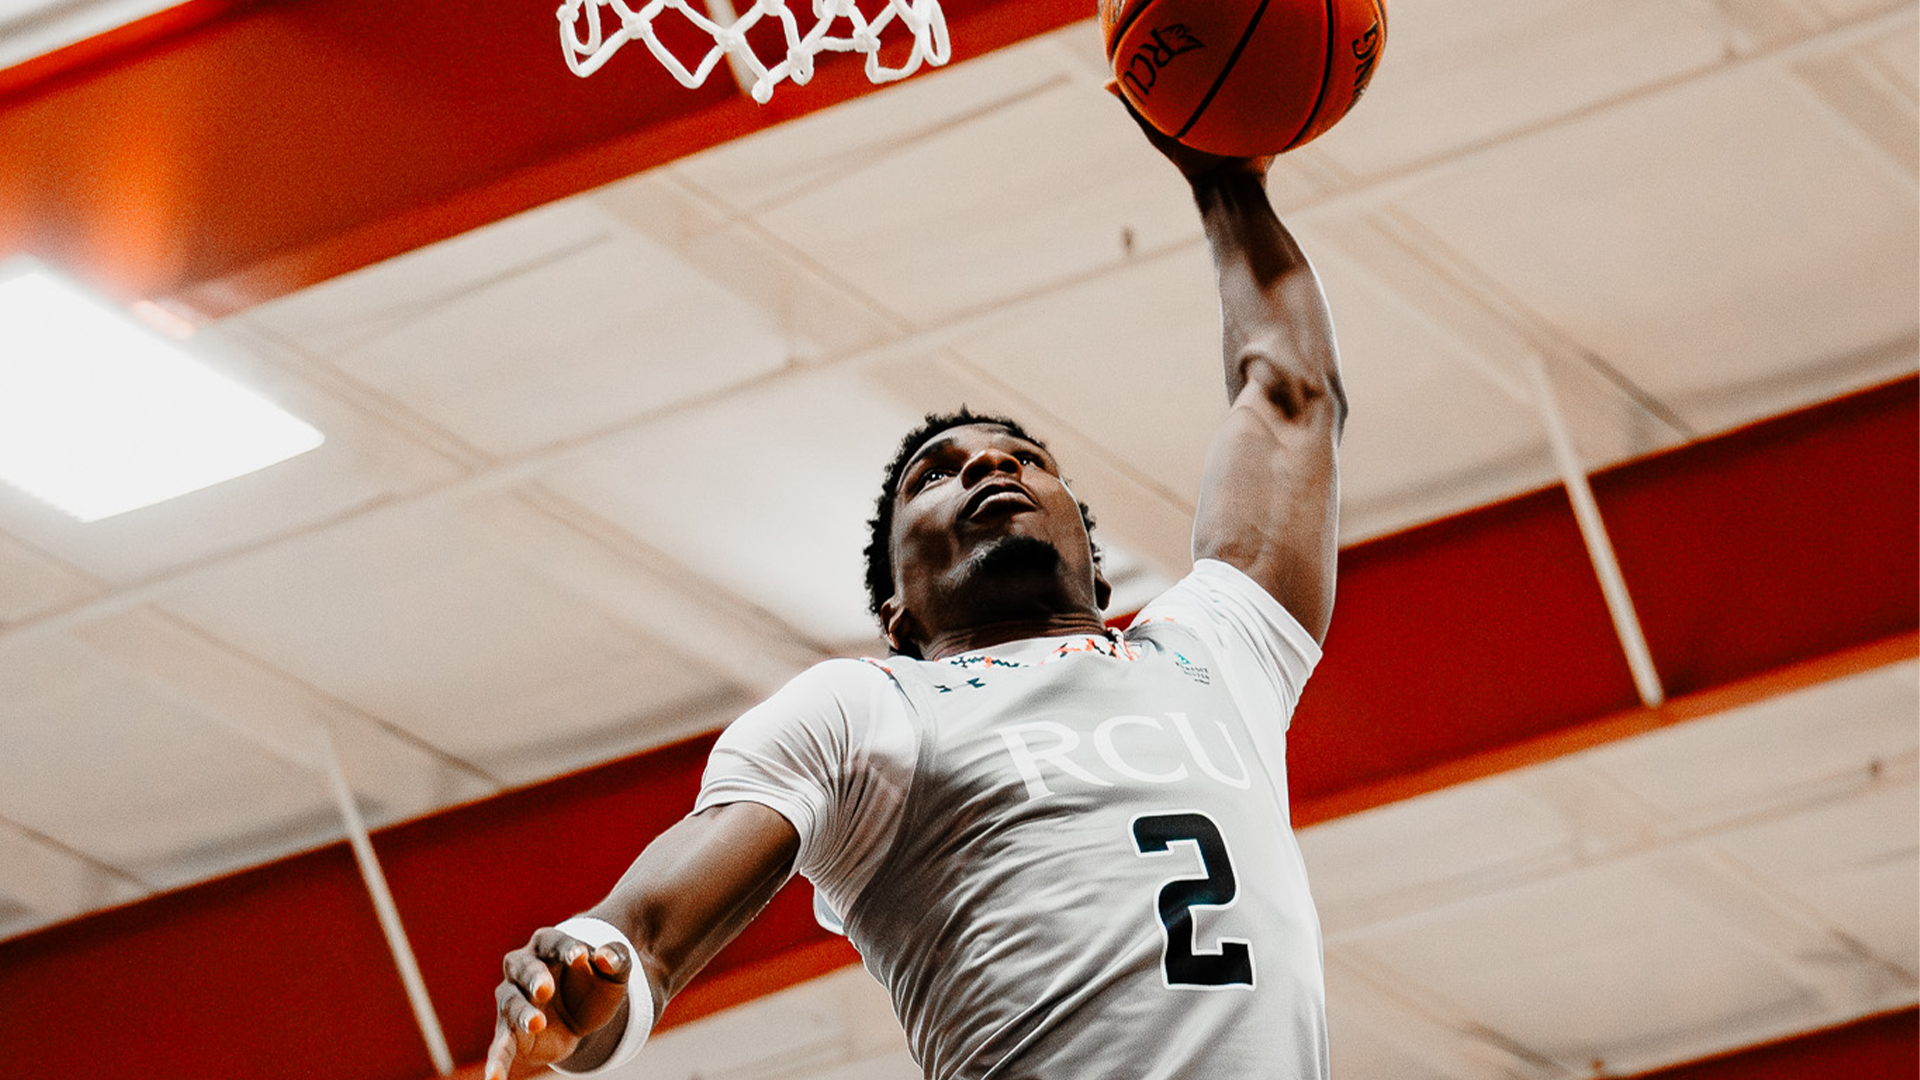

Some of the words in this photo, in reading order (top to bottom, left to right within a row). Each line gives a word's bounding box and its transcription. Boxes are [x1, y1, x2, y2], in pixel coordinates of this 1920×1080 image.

[1123, 28, 1174, 106] RCU
[990, 711, 1252, 801] RCU
[1127, 809, 1256, 991] 2
